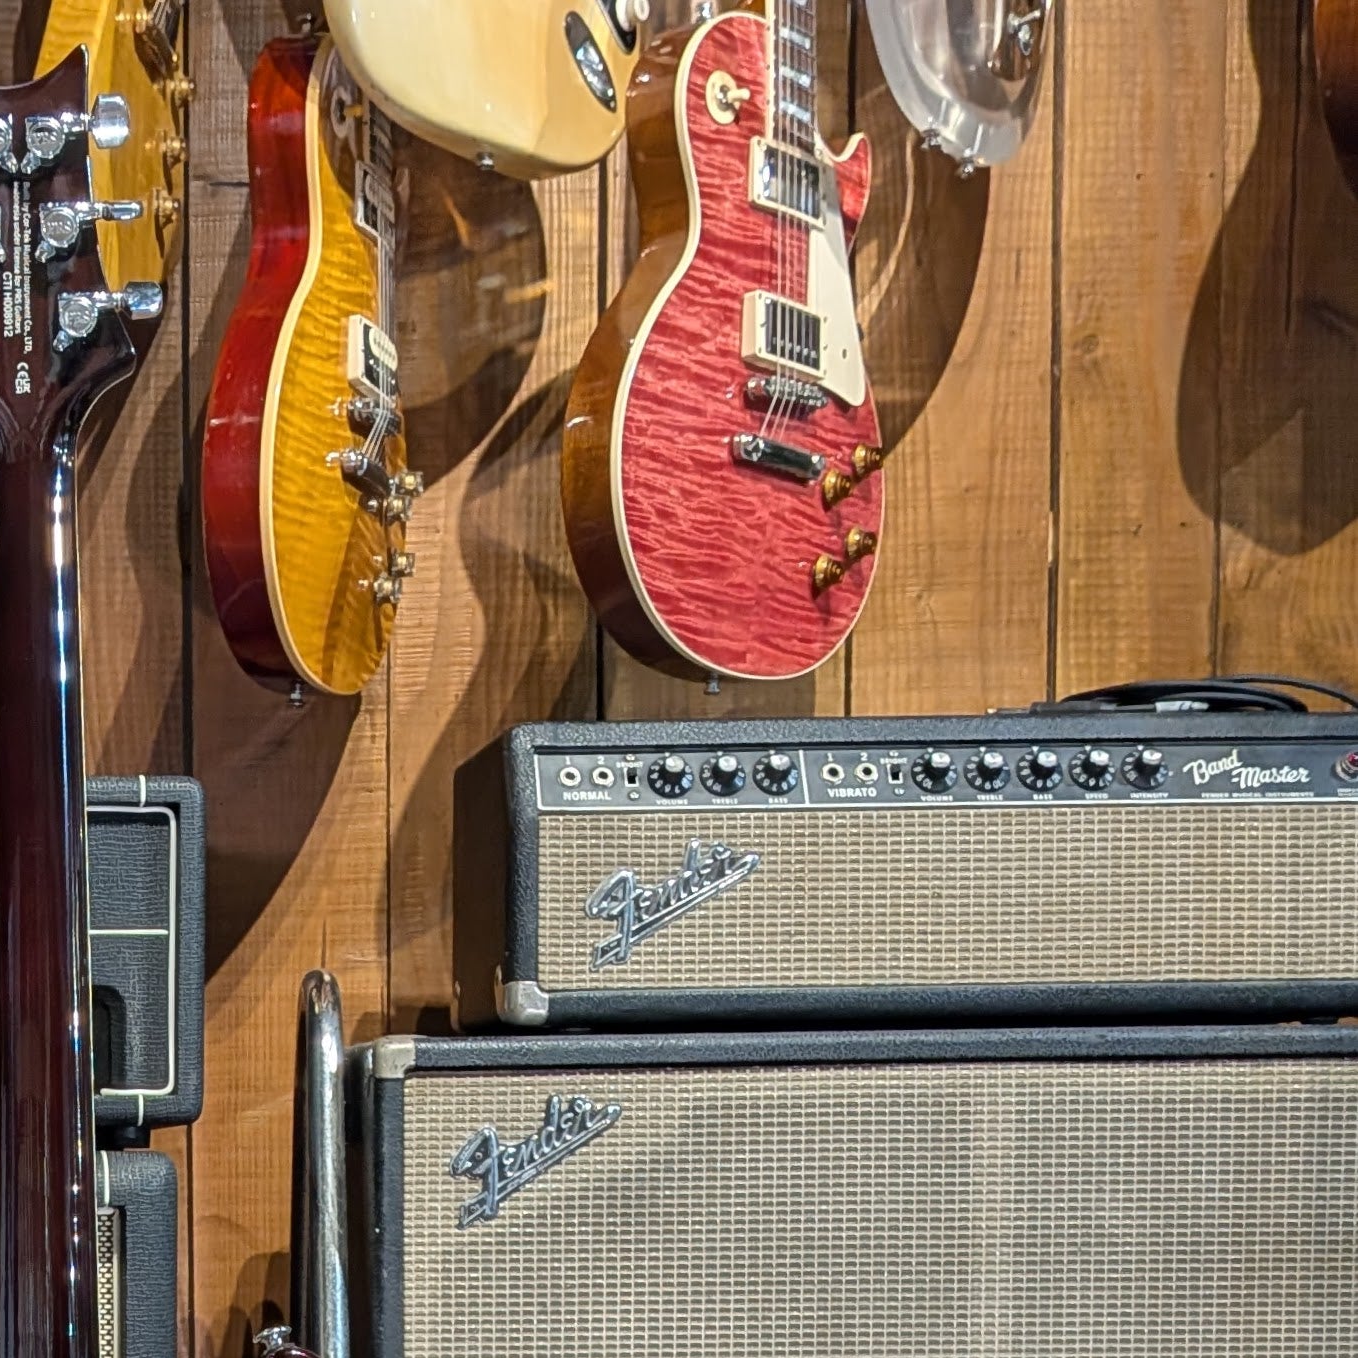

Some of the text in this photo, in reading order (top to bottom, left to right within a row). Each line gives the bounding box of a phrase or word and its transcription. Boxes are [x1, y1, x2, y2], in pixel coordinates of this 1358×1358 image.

[21, 202, 31, 212] by
[13, 222, 21, 245] under
[23, 213, 32, 244] Cor-Tek
[13, 246, 22, 275] license
[23, 245, 32, 275] Musical
[2, 271, 13, 290] CTI
[14, 275, 22, 288] for
[14, 288, 22, 304] PRS
[24, 275, 32, 319] Instrument
[14, 305, 23, 335] Guitars
[1182, 749, 1244, 785] Band
[563, 791, 612, 801] NORMAL
[827, 787, 877, 798] VIBRATO
[585, 837, 760, 971] Fender
[450, 1093, 622, 1229] Fender
